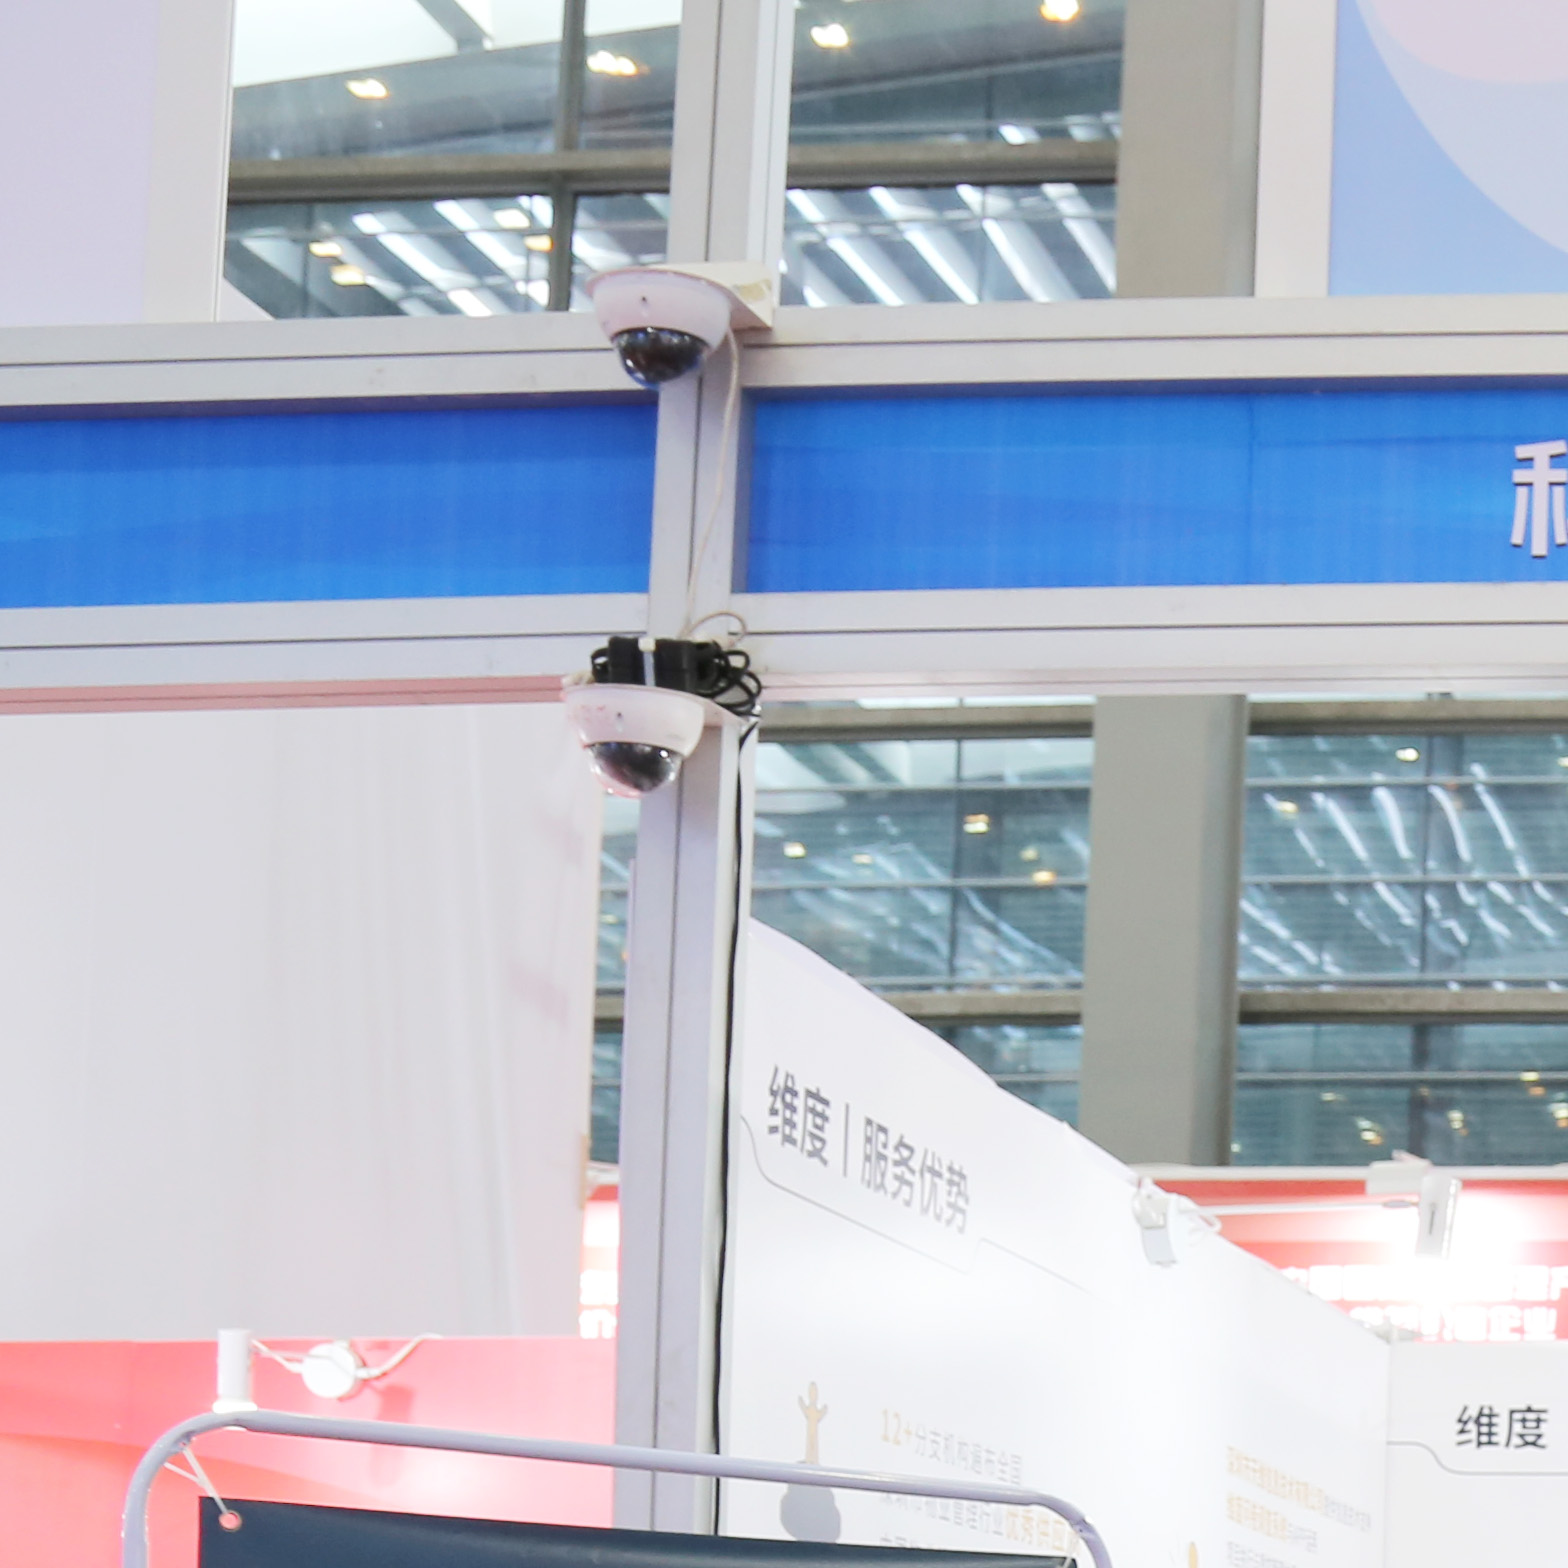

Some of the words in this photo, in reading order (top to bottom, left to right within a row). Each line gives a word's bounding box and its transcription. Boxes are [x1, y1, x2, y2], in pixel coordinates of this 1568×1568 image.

[768, 1066, 831, 1167] 维度
[861, 1116, 971, 1234] 服务优势
[1455, 1405, 1548, 1450] 维度
